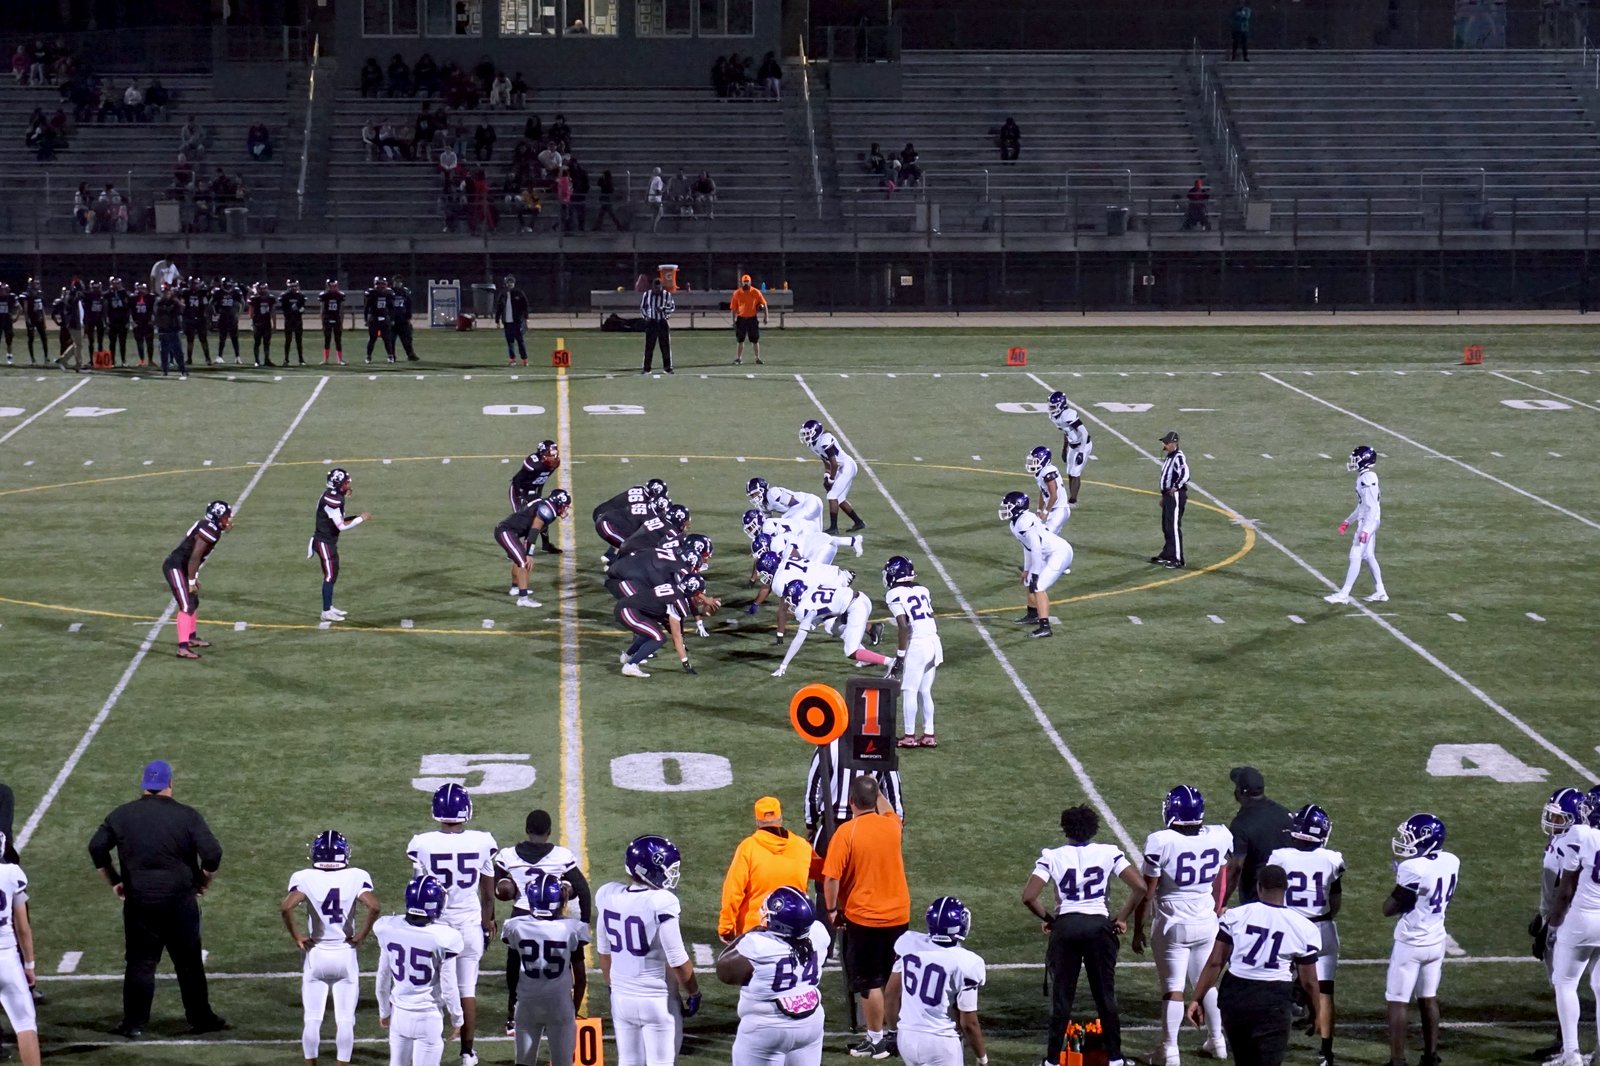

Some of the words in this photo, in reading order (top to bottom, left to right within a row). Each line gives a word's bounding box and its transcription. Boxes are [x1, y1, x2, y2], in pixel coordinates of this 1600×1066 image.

[554, 351, 569, 365] 50
[1010, 350, 1025, 363] 40
[1468, 349, 1482, 361] 30
[628, 487, 644, 503] 86
[861, 688, 881, 736] 1
[429, 852, 480, 889] 55
[1059, 866, 1105, 901] 42
[1174, 848, 1220, 886] 62
[320, 887, 343, 924] 4
[1285, 871, 1327, 907] 21
[1429, 873, 1456, 914] 44
[603, 909, 650, 956] 50
[1242, 924, 1285, 969] 71
[386, 942, 433, 986] 35
[518, 939, 567, 979] 25
[771, 950, 819, 992] 64
[902, 953, 947, 1007] 60
